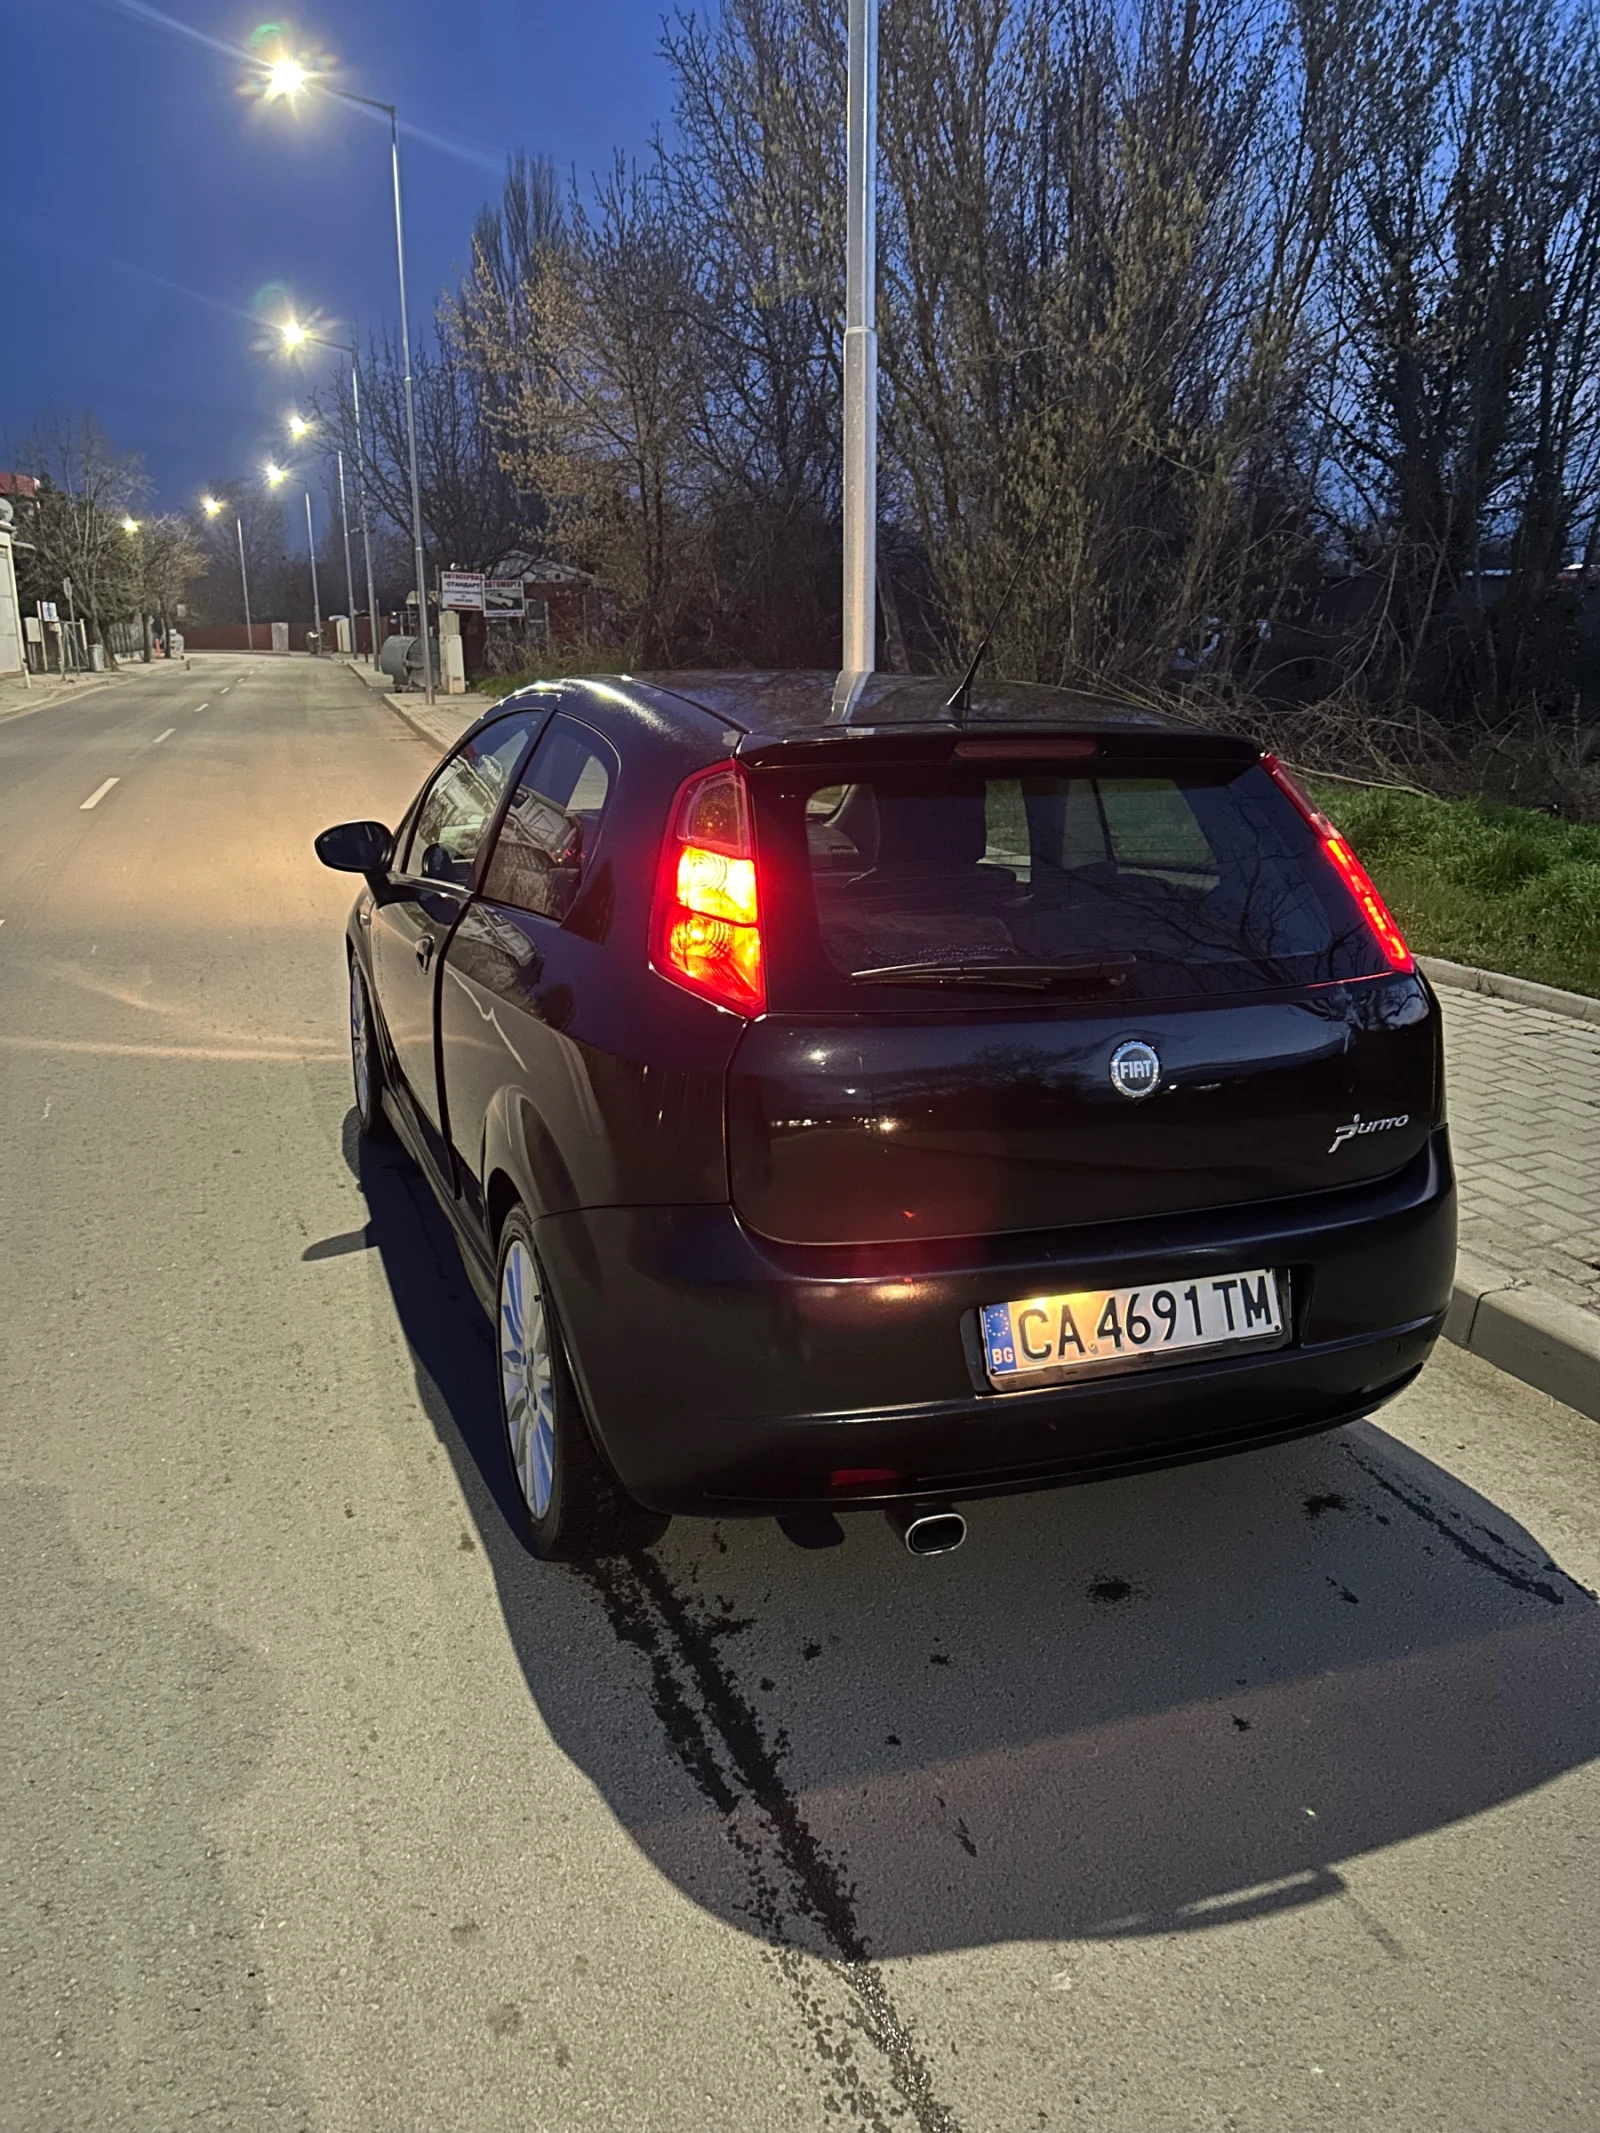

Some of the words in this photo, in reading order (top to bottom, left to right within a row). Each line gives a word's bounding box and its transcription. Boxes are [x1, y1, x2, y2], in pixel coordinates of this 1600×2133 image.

[1120, 1059, 1152, 1079] FIAT
[1018, 1304, 1086, 1362] CA
[1096, 1286, 1203, 1348] 4691
[1212, 1275, 1273, 1332] TM
[992, 1347, 1014, 1364] BG
